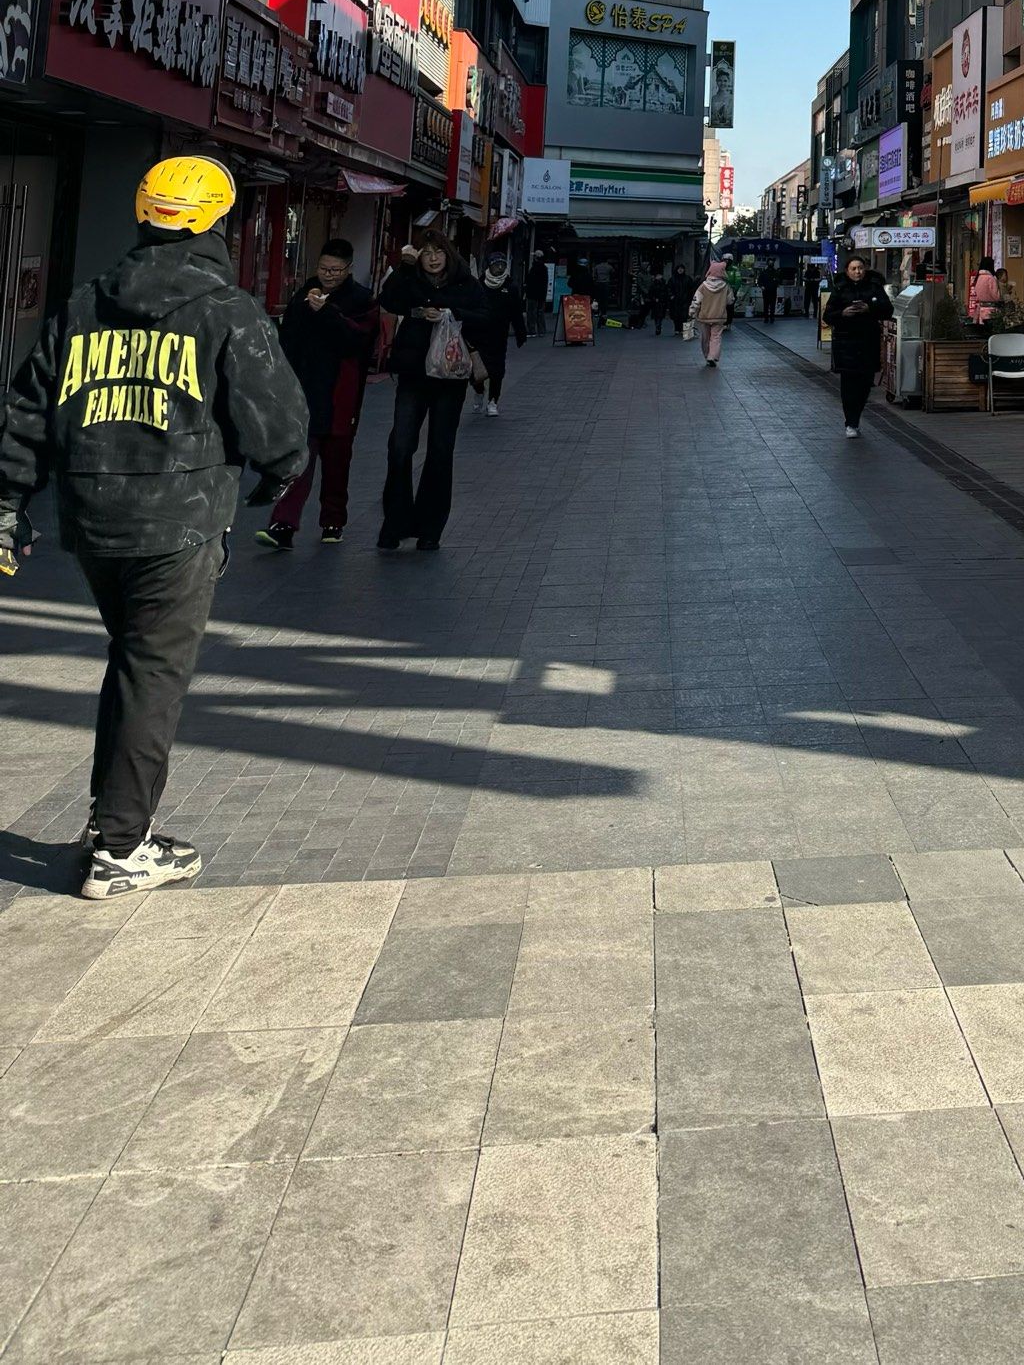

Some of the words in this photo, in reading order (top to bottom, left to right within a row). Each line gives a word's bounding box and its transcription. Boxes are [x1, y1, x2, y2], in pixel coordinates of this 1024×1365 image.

[583, 183, 626, 195] FamilyMart
[57, 329, 204, 407] AMERICA
[82, 385, 169, 431] FAMILLE
